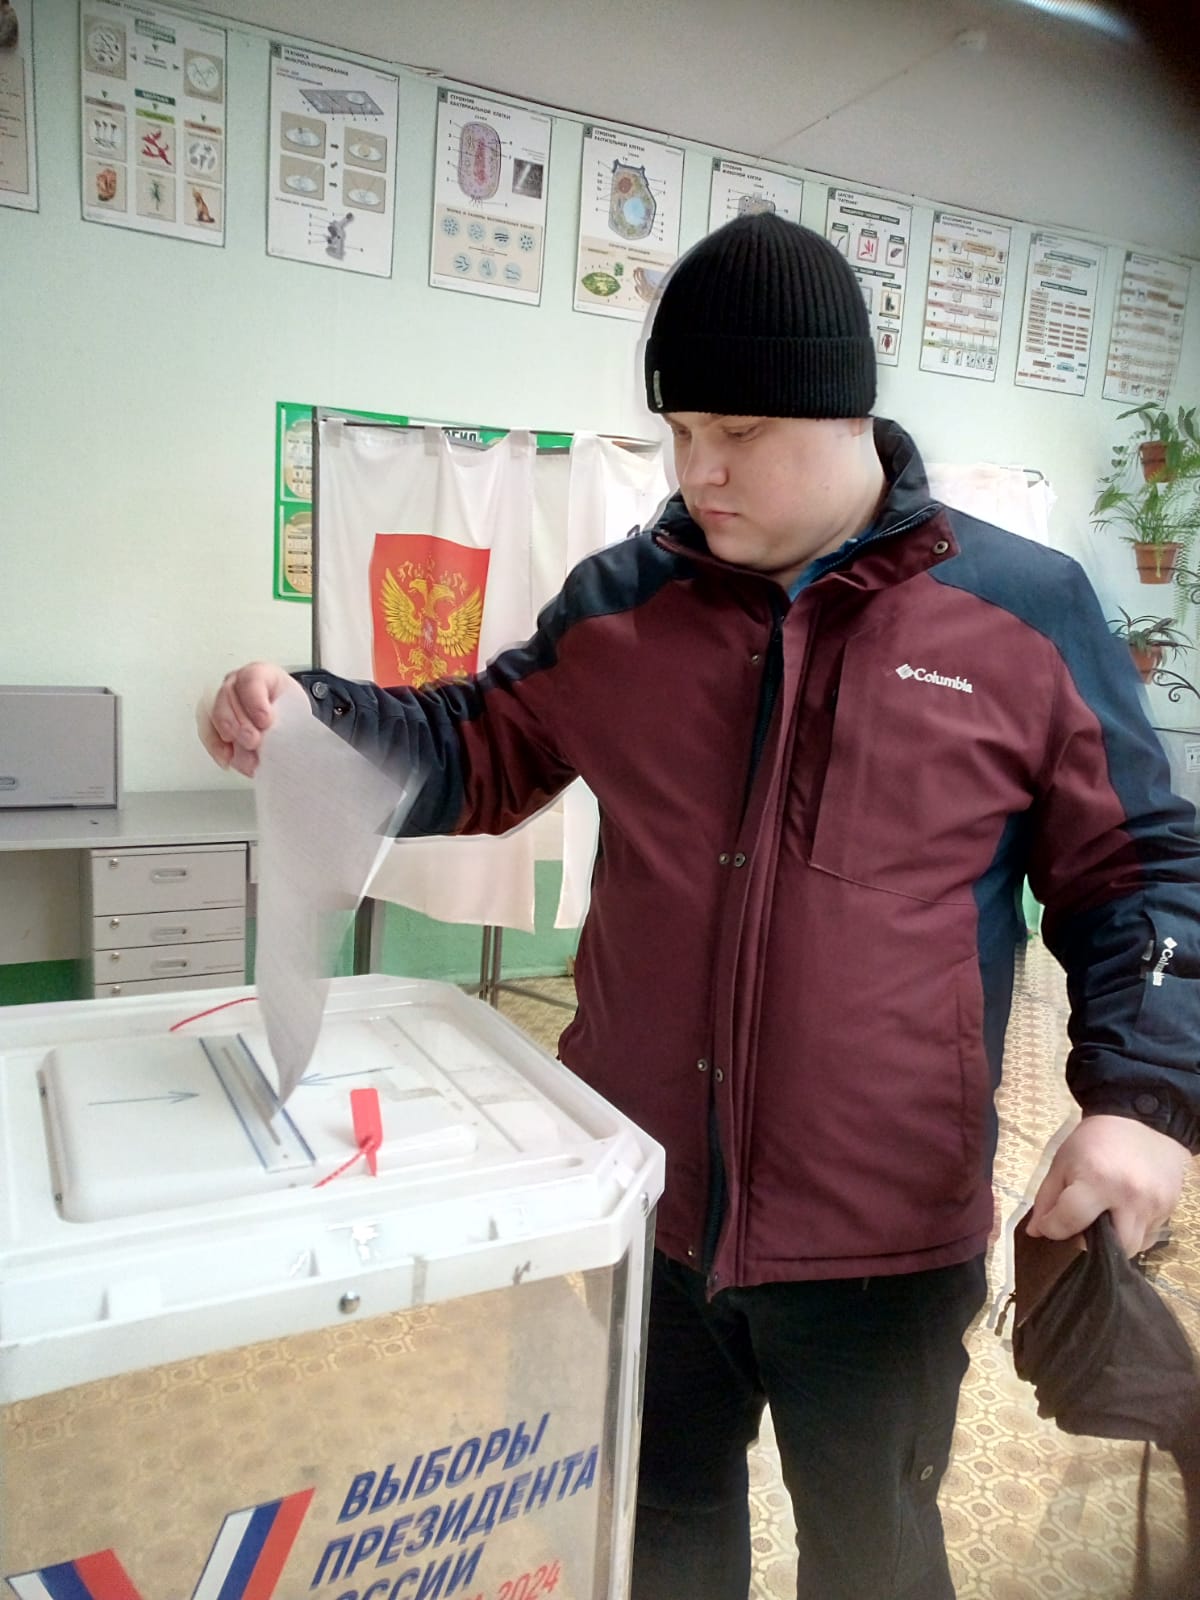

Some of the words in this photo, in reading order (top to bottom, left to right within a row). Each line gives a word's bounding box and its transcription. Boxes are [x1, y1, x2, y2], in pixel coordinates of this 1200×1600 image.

[913, 667, 974, 694] Columbia
[309, 1444, 599, 1591] ПРЕЗИДЕНТА
[336, 1412, 550, 1525] ВЫБОРЫ
